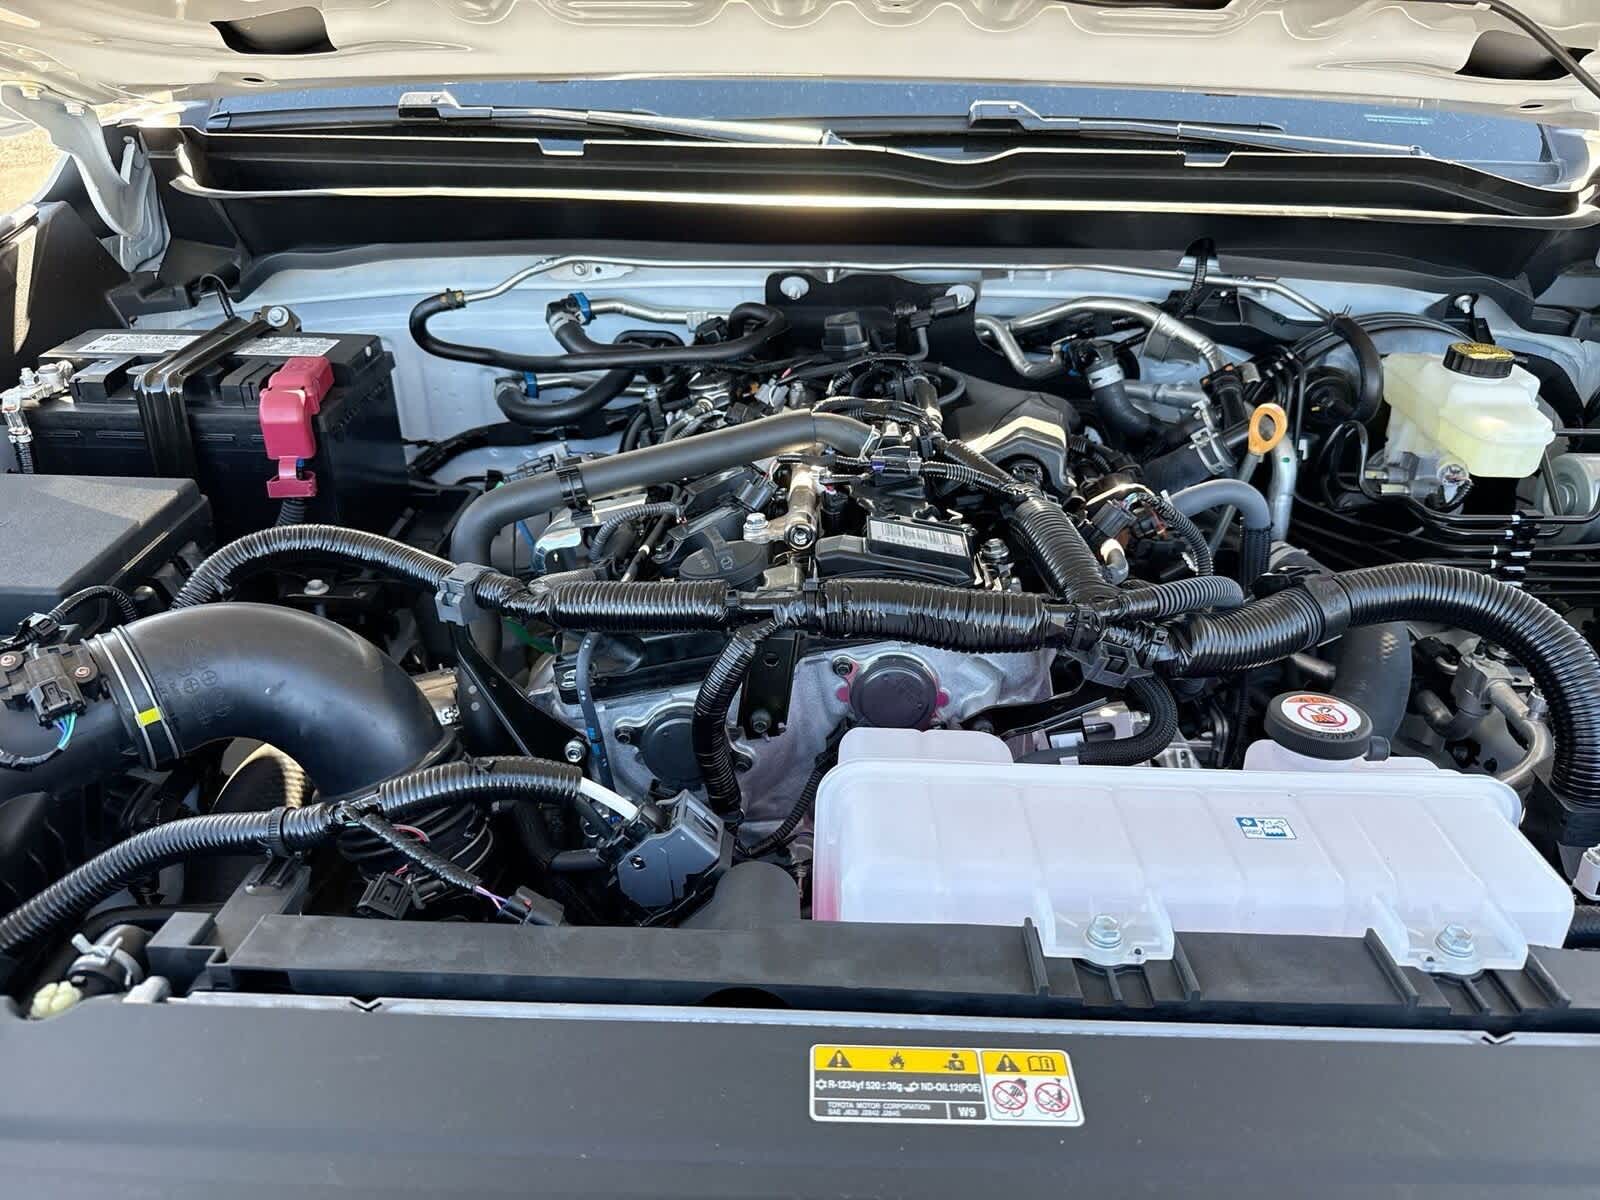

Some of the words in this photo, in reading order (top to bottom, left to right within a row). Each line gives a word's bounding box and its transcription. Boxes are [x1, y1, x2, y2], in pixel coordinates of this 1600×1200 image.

[828, 1080, 864, 1091] R-1234yf
[882, 1102, 931, 1111] CORPORATION
[957, 1107, 977, 1117] W9
